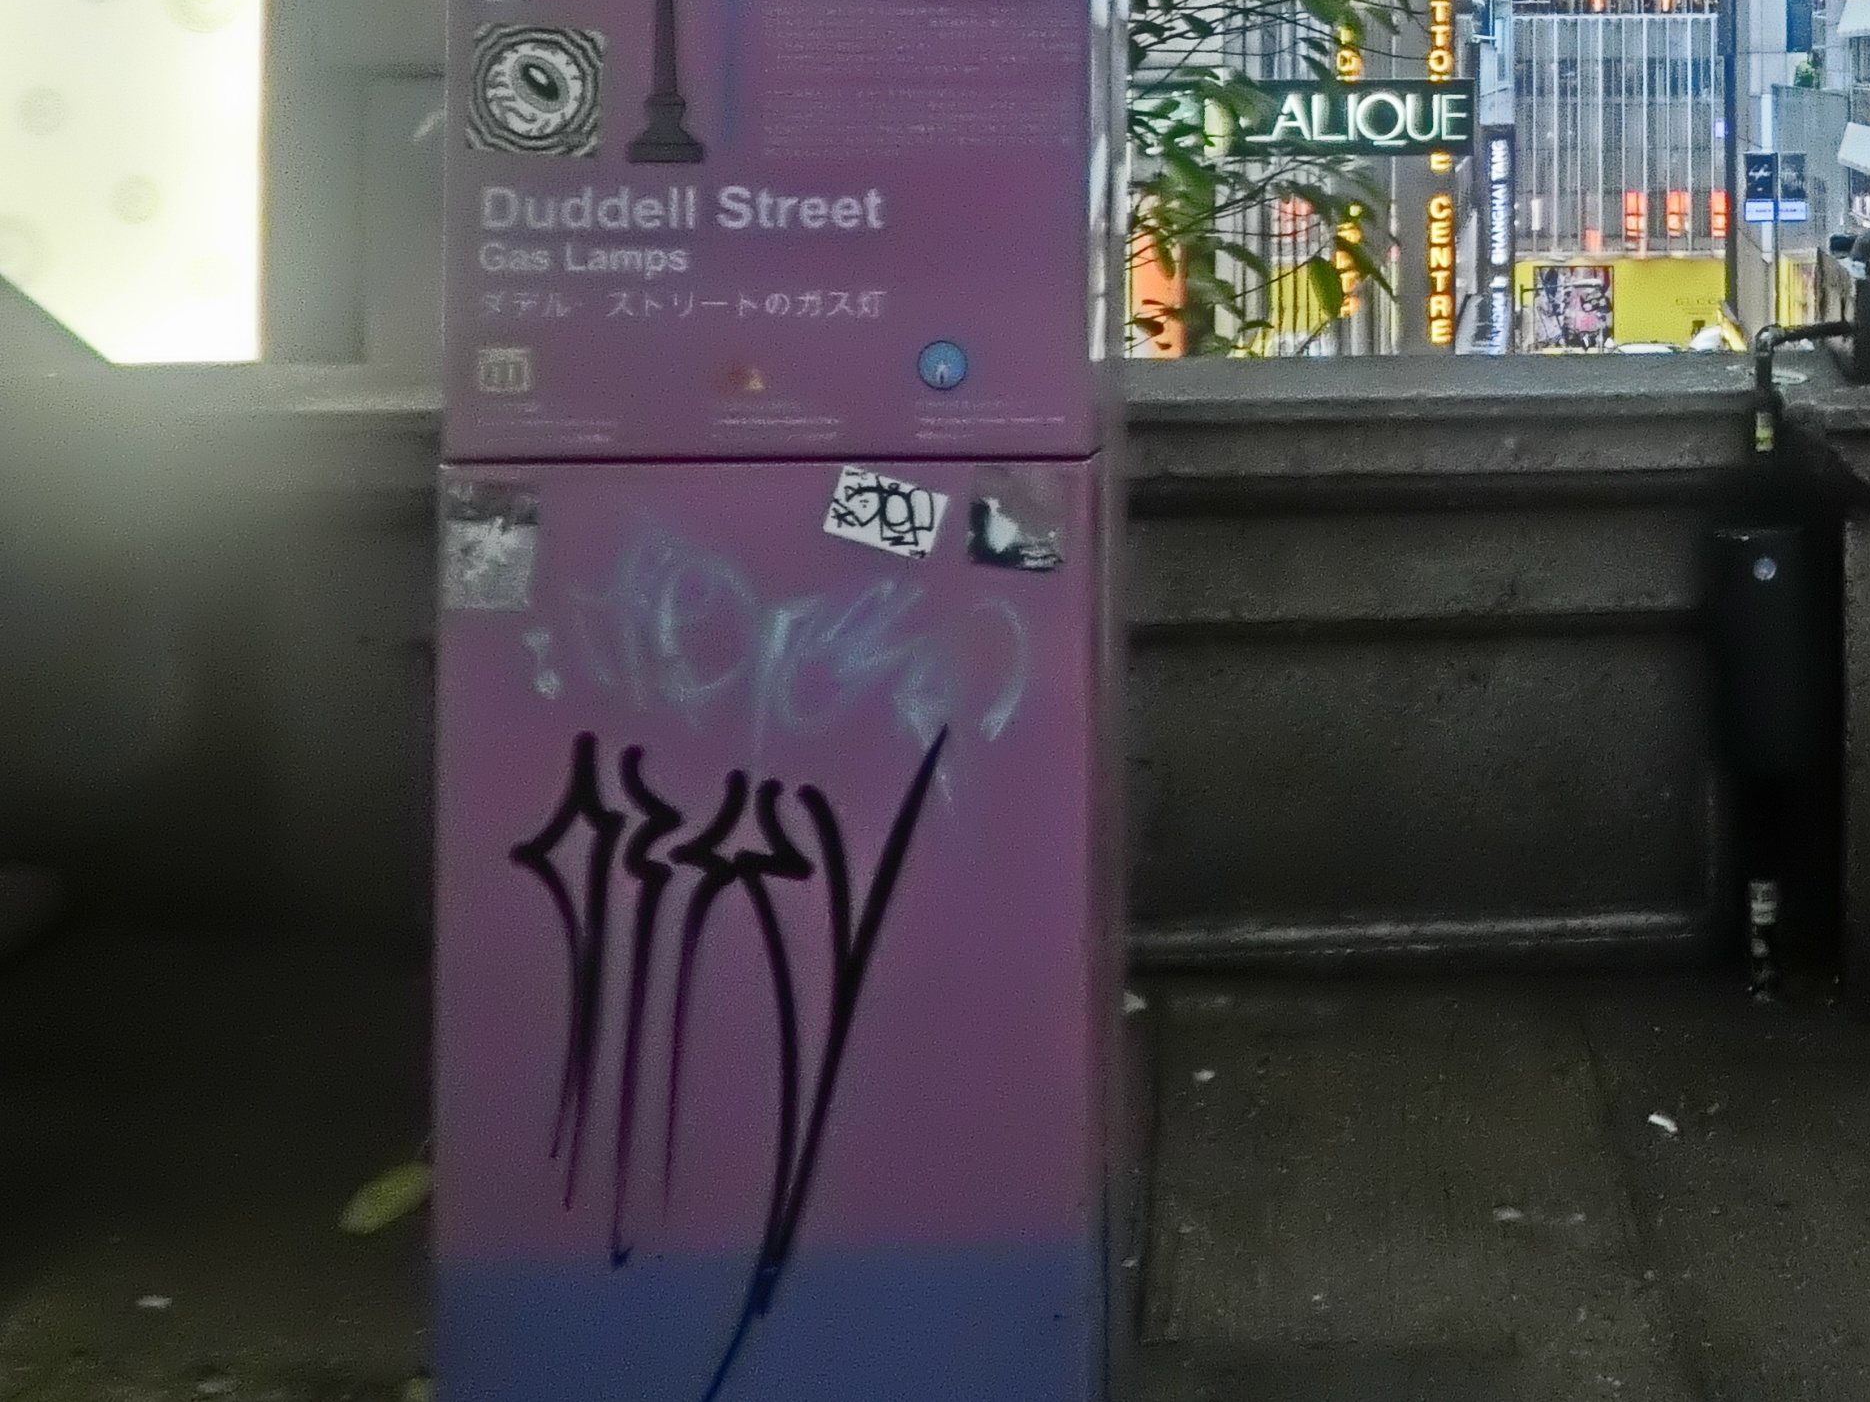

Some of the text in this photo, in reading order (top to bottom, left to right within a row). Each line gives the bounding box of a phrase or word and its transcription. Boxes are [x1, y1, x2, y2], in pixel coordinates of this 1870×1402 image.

[1490, 139, 1511, 182] TANG
[480, 186, 885, 230] Duddell Street
[1490, 184, 1509, 265] SHANGHAI
[478, 243, 690, 279] Gas Lamps
[1429, 196, 1453, 344] CENTRE
